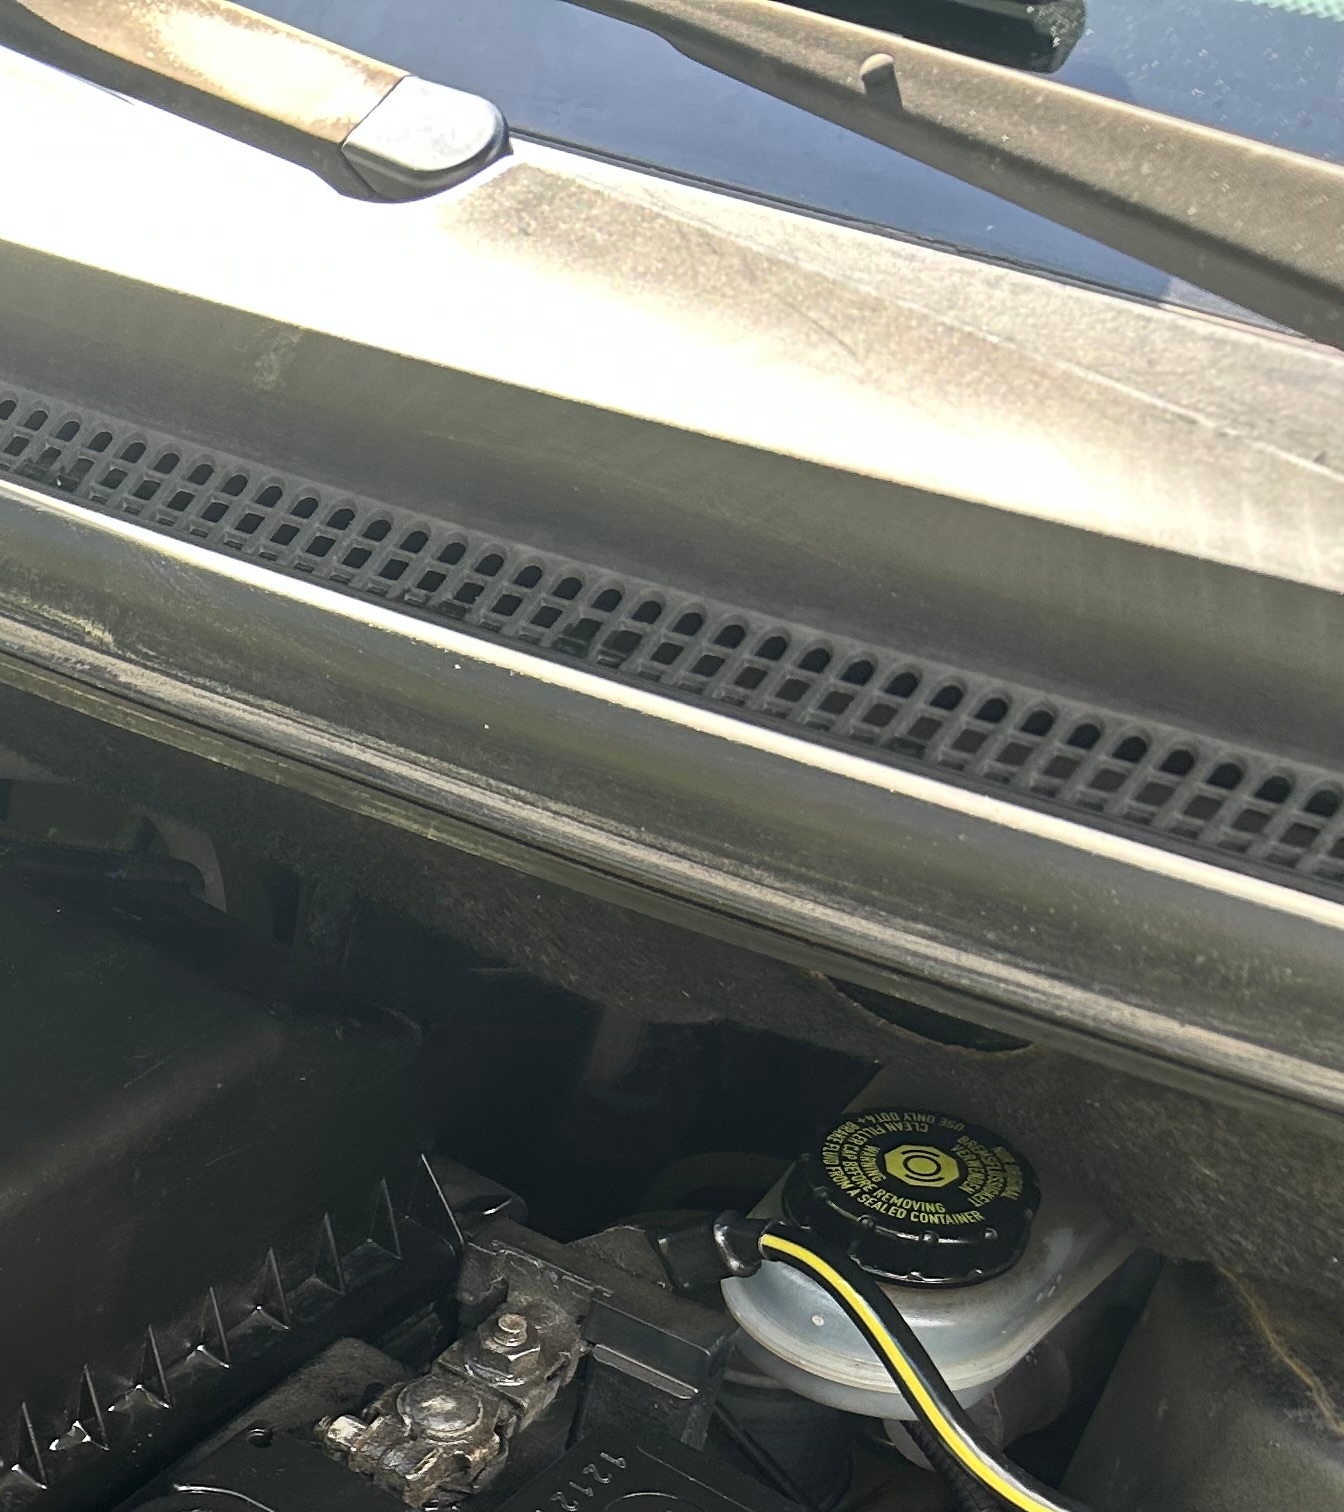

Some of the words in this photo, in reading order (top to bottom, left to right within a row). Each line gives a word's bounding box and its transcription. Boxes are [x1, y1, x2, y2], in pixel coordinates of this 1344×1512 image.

[886, 1122, 928, 1132] CLEAN
[902, 1112, 935, 1123] ONLY
[853, 1125, 884, 1144] FILLER
[860, 1145, 884, 1182] WARNING
[828, 1163, 853, 1189] FROM
[841, 1160, 878, 1191] BEFORE
[846, 1188, 861, 1197] A
[874, 1188, 946, 1213] REMOVING
[857, 1193, 906, 1218] SEALED
[910, 1210, 985, 1225] CONTAINER
